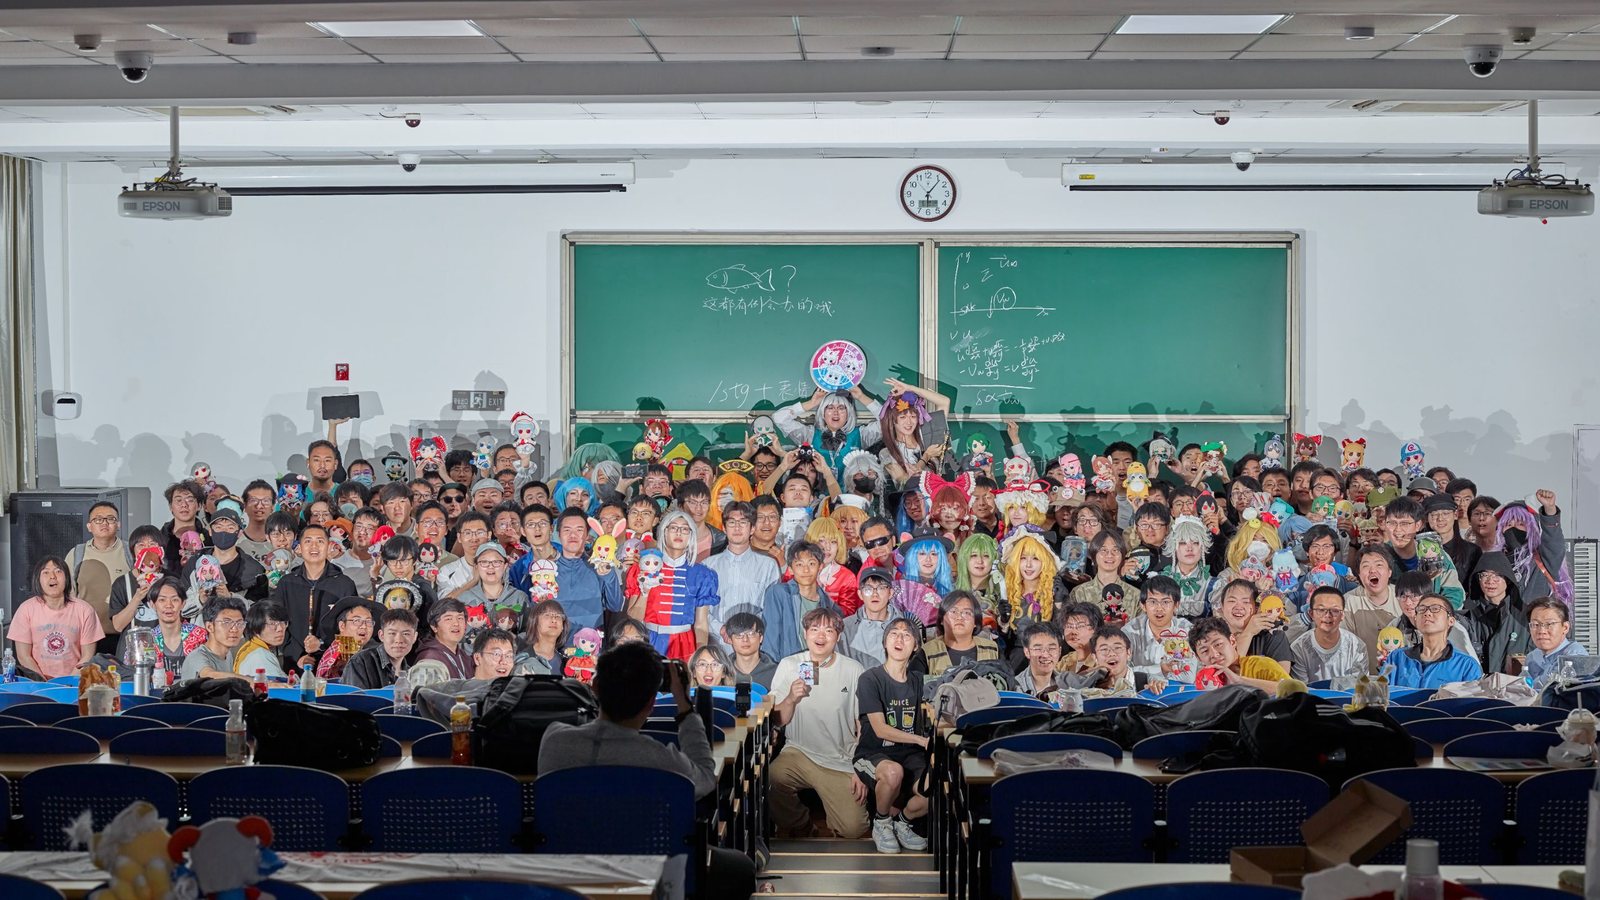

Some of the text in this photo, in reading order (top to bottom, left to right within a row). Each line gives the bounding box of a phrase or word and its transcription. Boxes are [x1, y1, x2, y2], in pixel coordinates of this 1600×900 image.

[142, 202, 180, 211] EPSON
[1529, 199, 1568, 209] EPSON
[488, 398, 503, 406] EXIT
